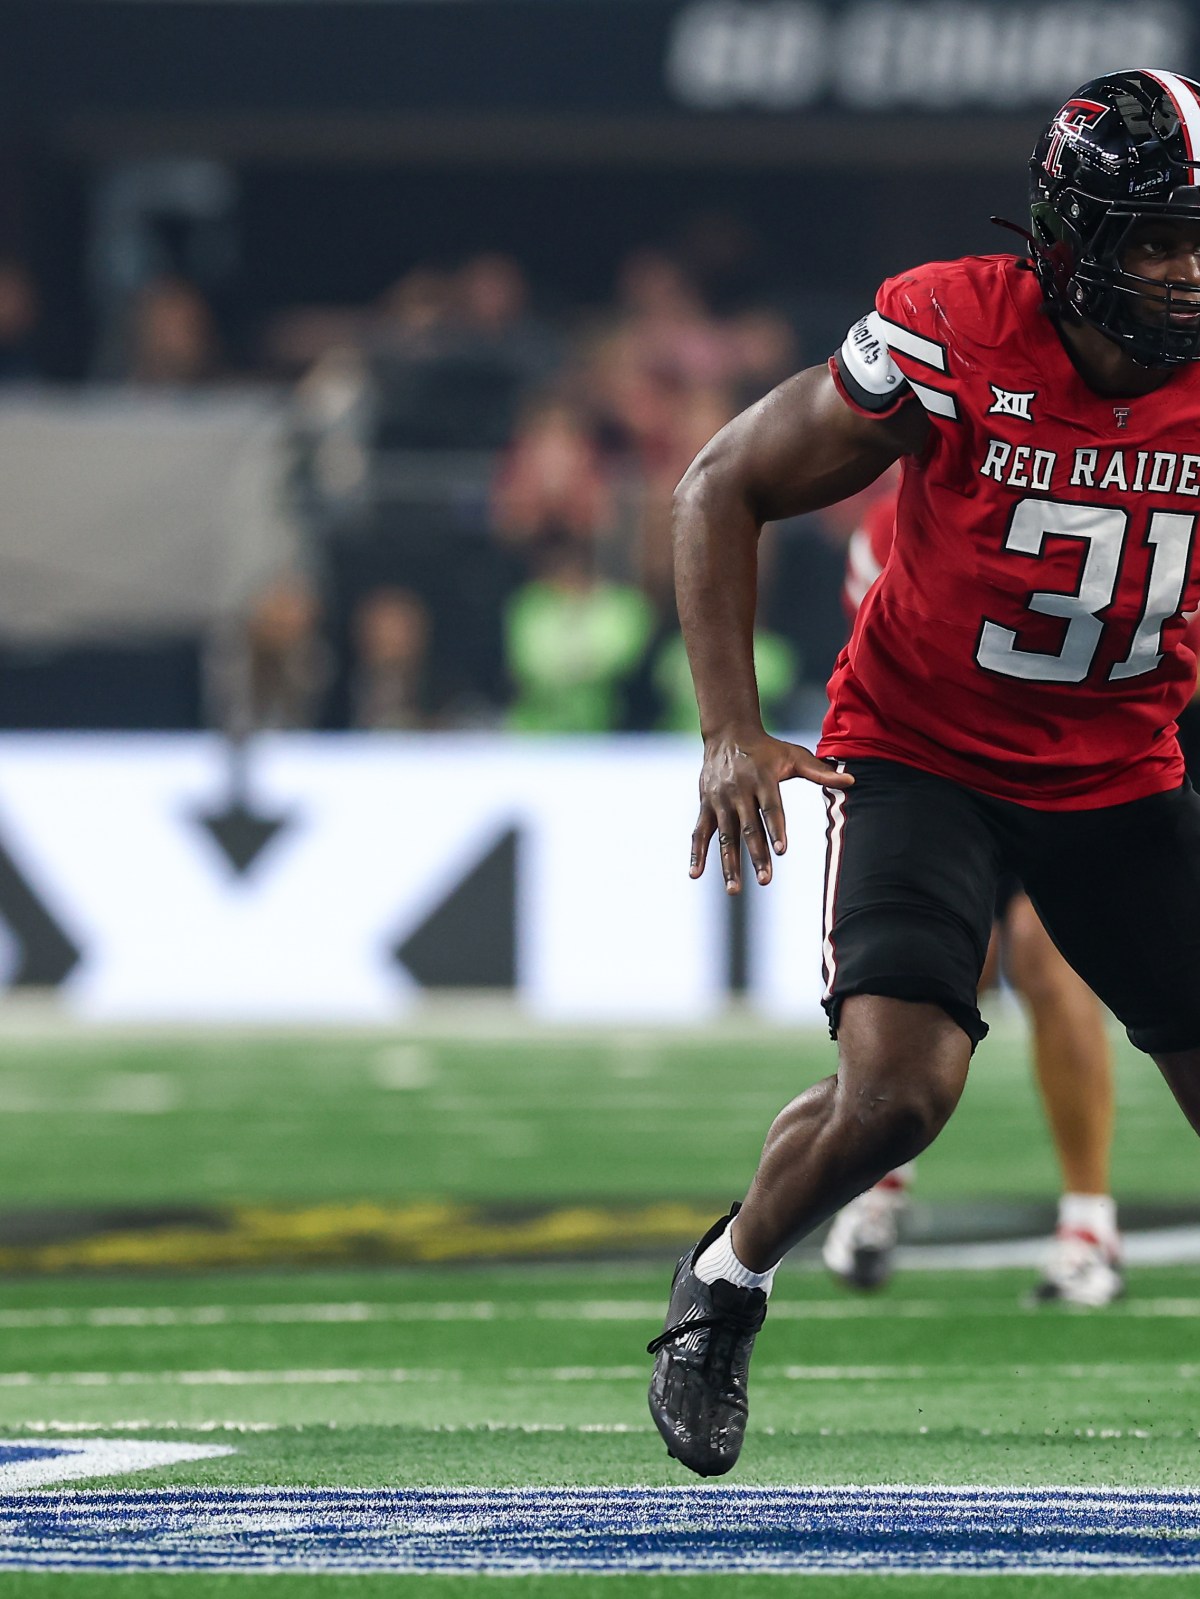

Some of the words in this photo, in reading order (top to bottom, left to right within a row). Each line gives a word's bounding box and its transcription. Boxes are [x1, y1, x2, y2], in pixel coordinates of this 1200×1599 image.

[989, 384, 1035, 421] XII
[979, 439, 1056, 491] RED
[974, 496, 1198, 685] 31
